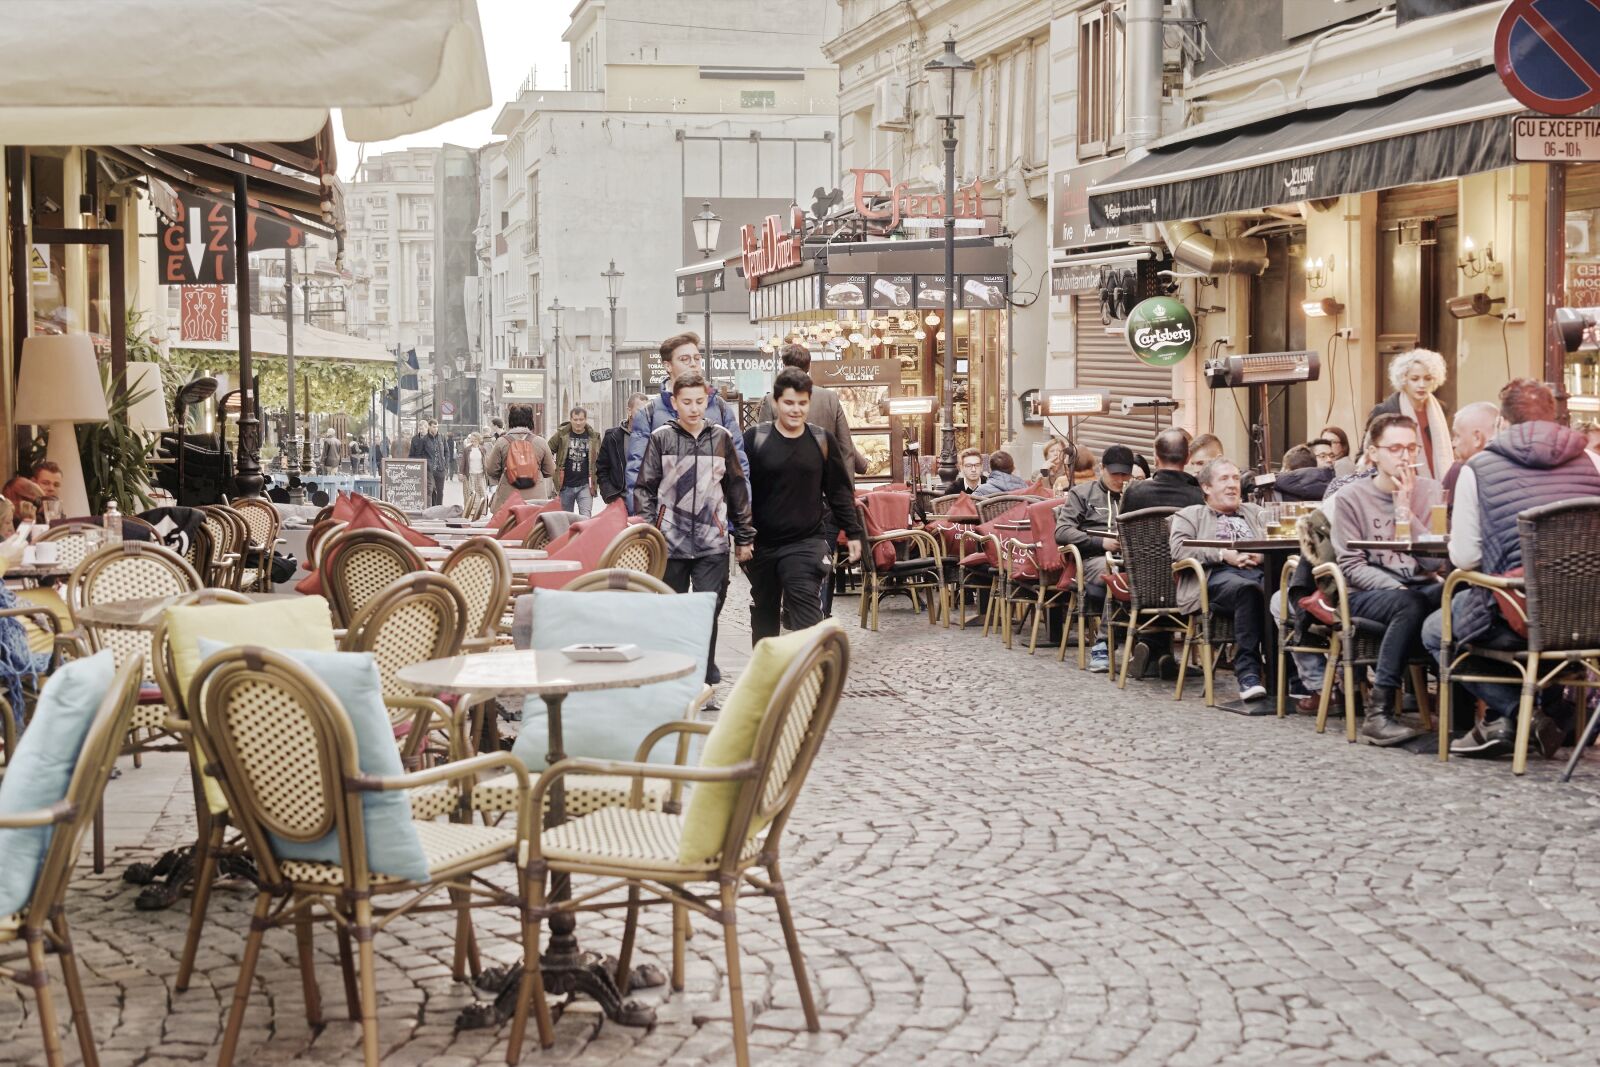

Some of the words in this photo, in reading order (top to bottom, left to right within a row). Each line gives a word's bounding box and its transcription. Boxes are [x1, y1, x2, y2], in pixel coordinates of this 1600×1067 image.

[1518, 121, 1536, 137] CU
[1134, 322, 1191, 350] Carlsberg
[730, 359, 737, 370] &
